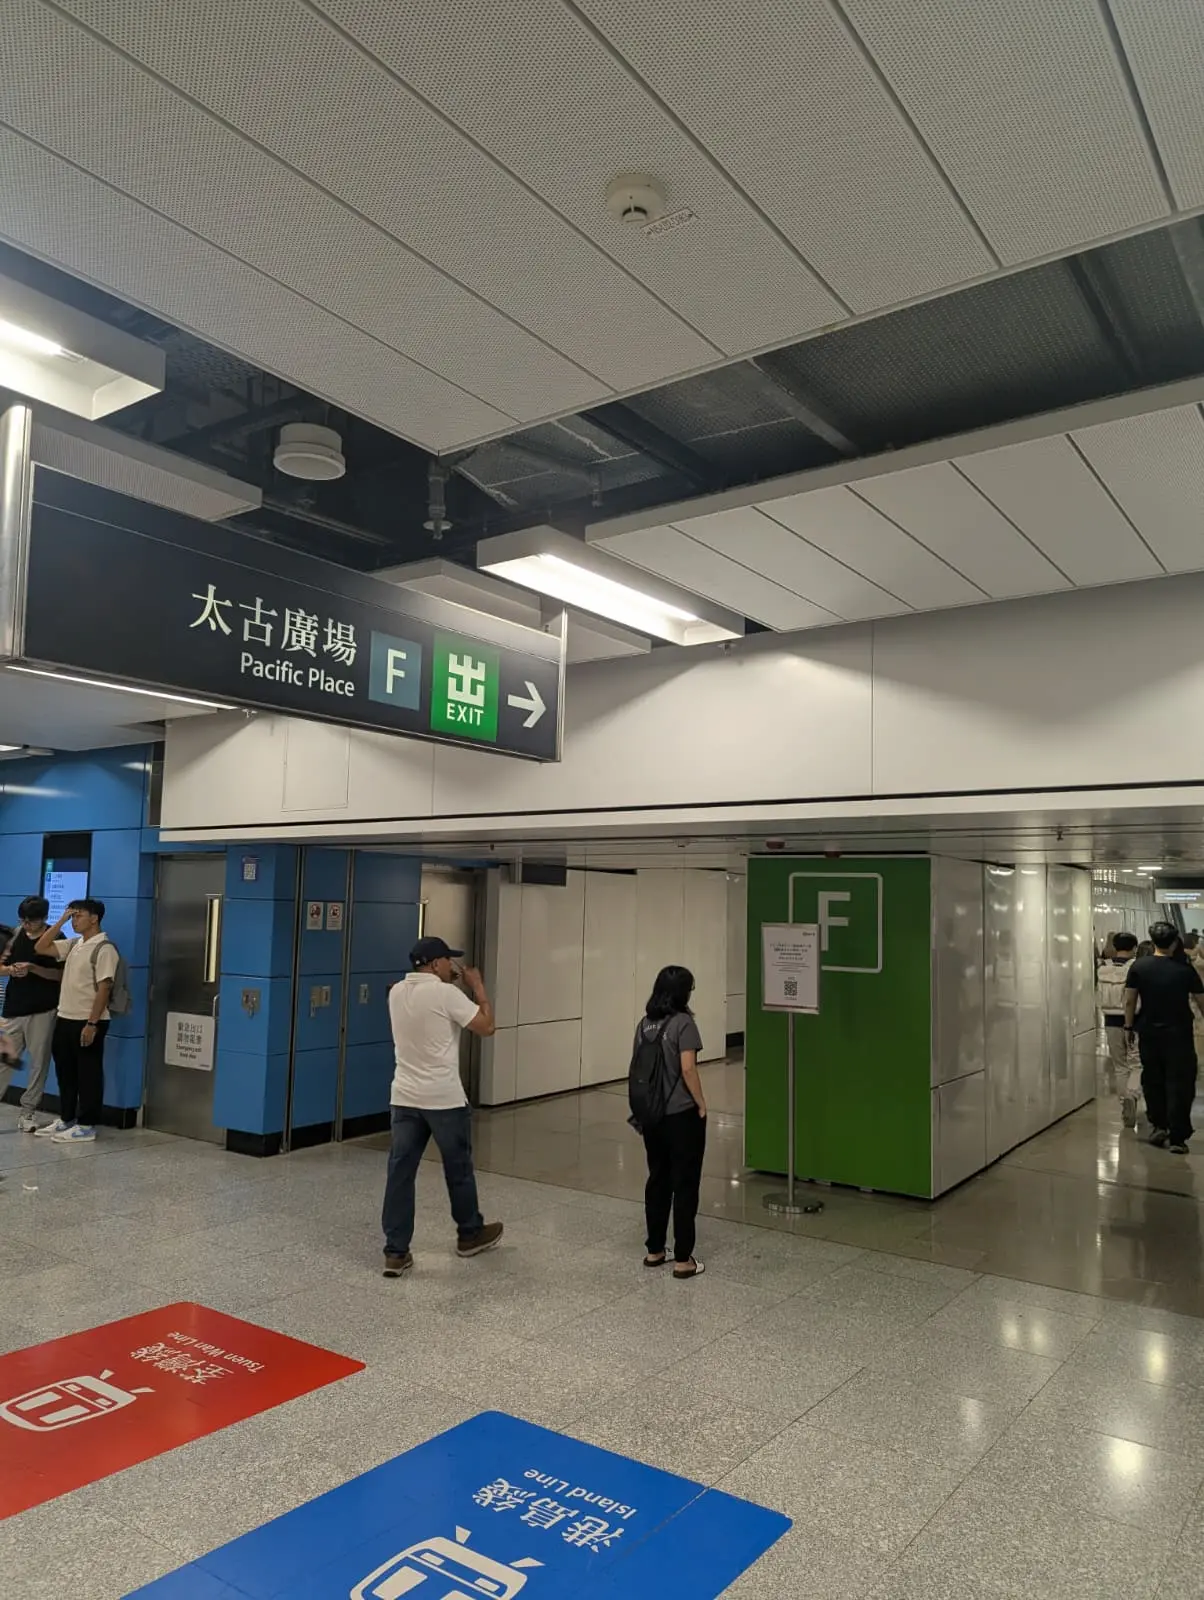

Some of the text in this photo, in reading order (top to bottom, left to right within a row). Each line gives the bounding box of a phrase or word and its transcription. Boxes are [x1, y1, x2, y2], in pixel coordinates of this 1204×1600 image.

[189, 584, 357, 666] 太古廣場
[240, 652, 355, 697] Pacific Place
[385, 648, 407, 694] F
[447, 652, 486, 707] 出
[446, 702, 485, 726] EXIT
[818, 891, 851, 951] F
[167, 1331, 265, 1373] Tsuen Wan Line
[472, 1477, 625, 1553] 港島綫
[523, 1468, 638, 1520] Island Line
